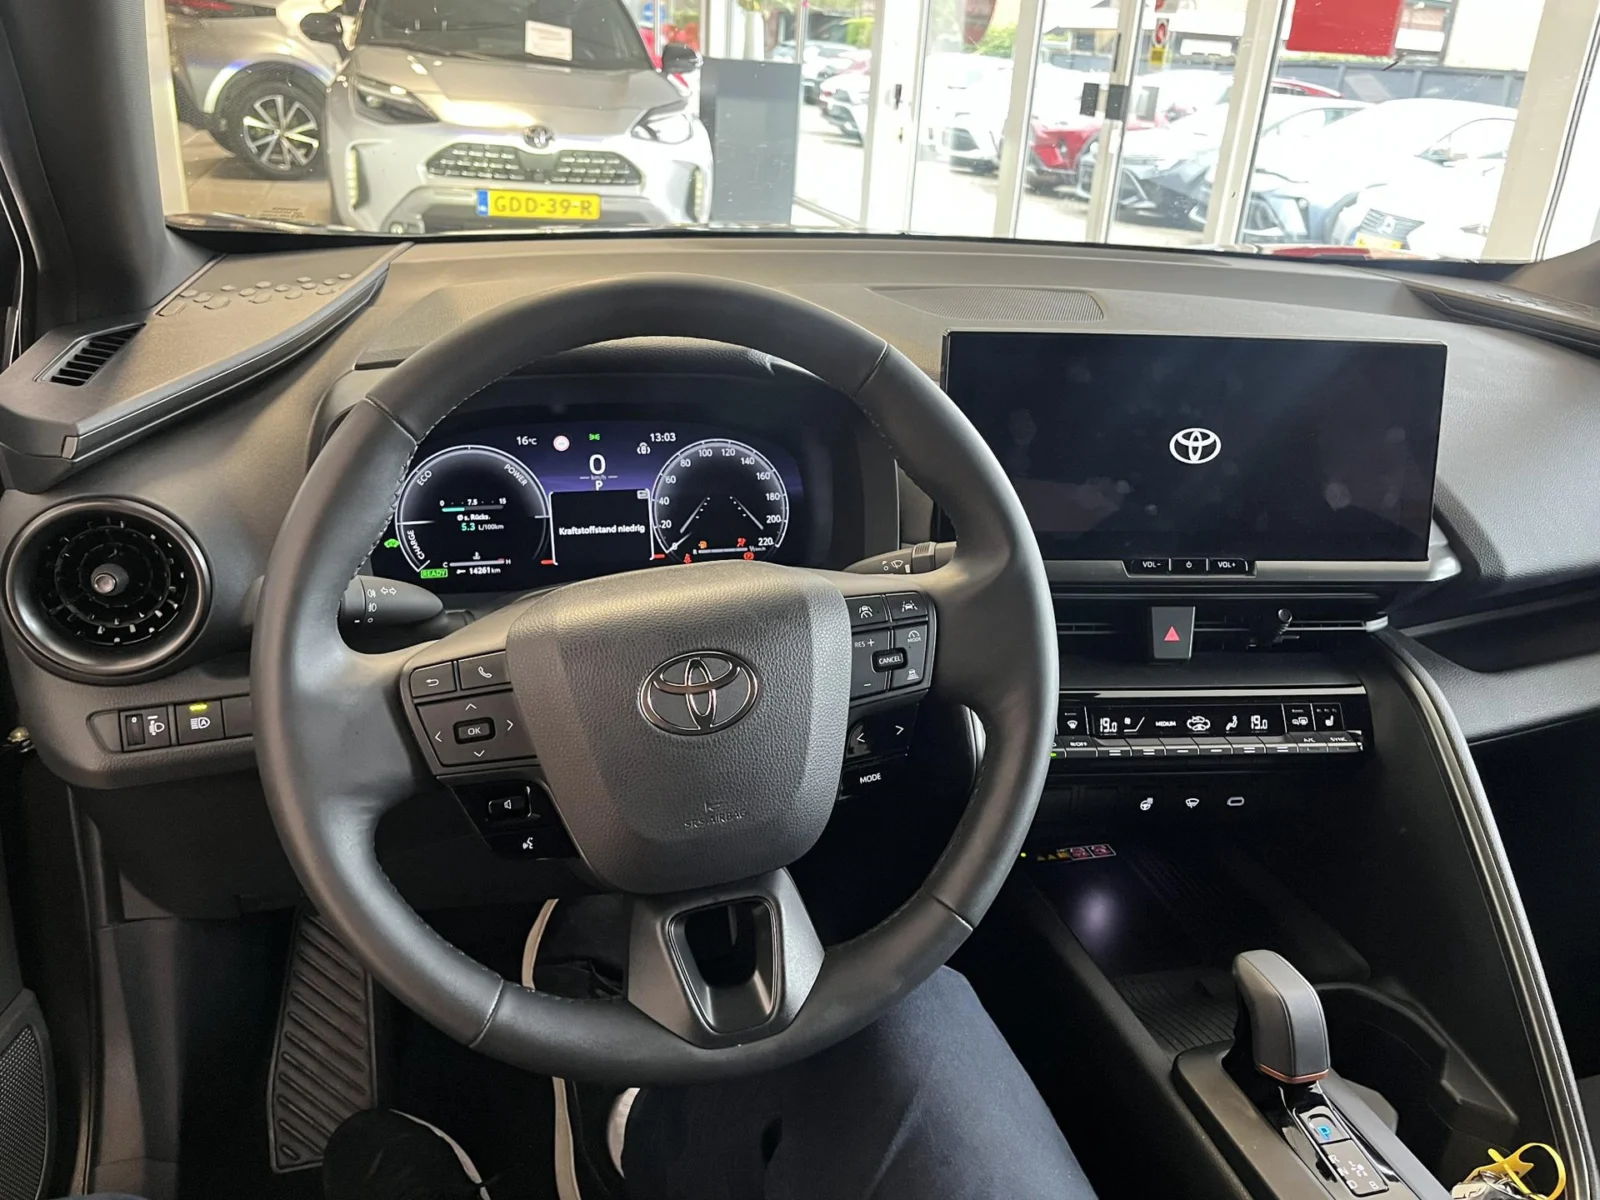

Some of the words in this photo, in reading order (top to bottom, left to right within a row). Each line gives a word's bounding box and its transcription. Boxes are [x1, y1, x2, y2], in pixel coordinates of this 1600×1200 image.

[493, 195, 593, 216] GDD-39-R
[650, 433, 676, 442] 13:03
[698, 448, 713, 457] 100
[721, 448, 736, 457] 120
[589, 454, 606, 475] 0
[679, 458, 692, 468] 80
[740, 457, 755, 466] 140
[416, 469, 433, 487] ECO
[504, 463, 528, 487] POWER
[665, 475, 677, 484] 60
[756, 472, 771, 481] 160
[595, 480, 604, 491] P
[658, 496, 670, 506] 40
[765, 492, 780, 501] 180
[660, 519, 672, 529] 20
[766, 514, 781, 524] 200
[461, 522, 476, 532] 5.3
[558, 526, 617, 536] Kraftstoffstand
[617, 524, 646, 534] niedrig
[407, 529, 426, 561] CHARGE
[757, 537, 774, 547] 220
[422, 569, 448, 577] READY
[468, 566, 491, 575] 14261
[878, 655, 902, 665] CANCEL
[1099, 717, 1118, 733] 19.0
[1250, 714, 1268, 730] 19.0
[467, 726, 482, 736] OK
[859, 772, 882, 784] MODE
[1317, 1126, 1331, 1140] P
[1328, 1154, 1341, 1164] R
